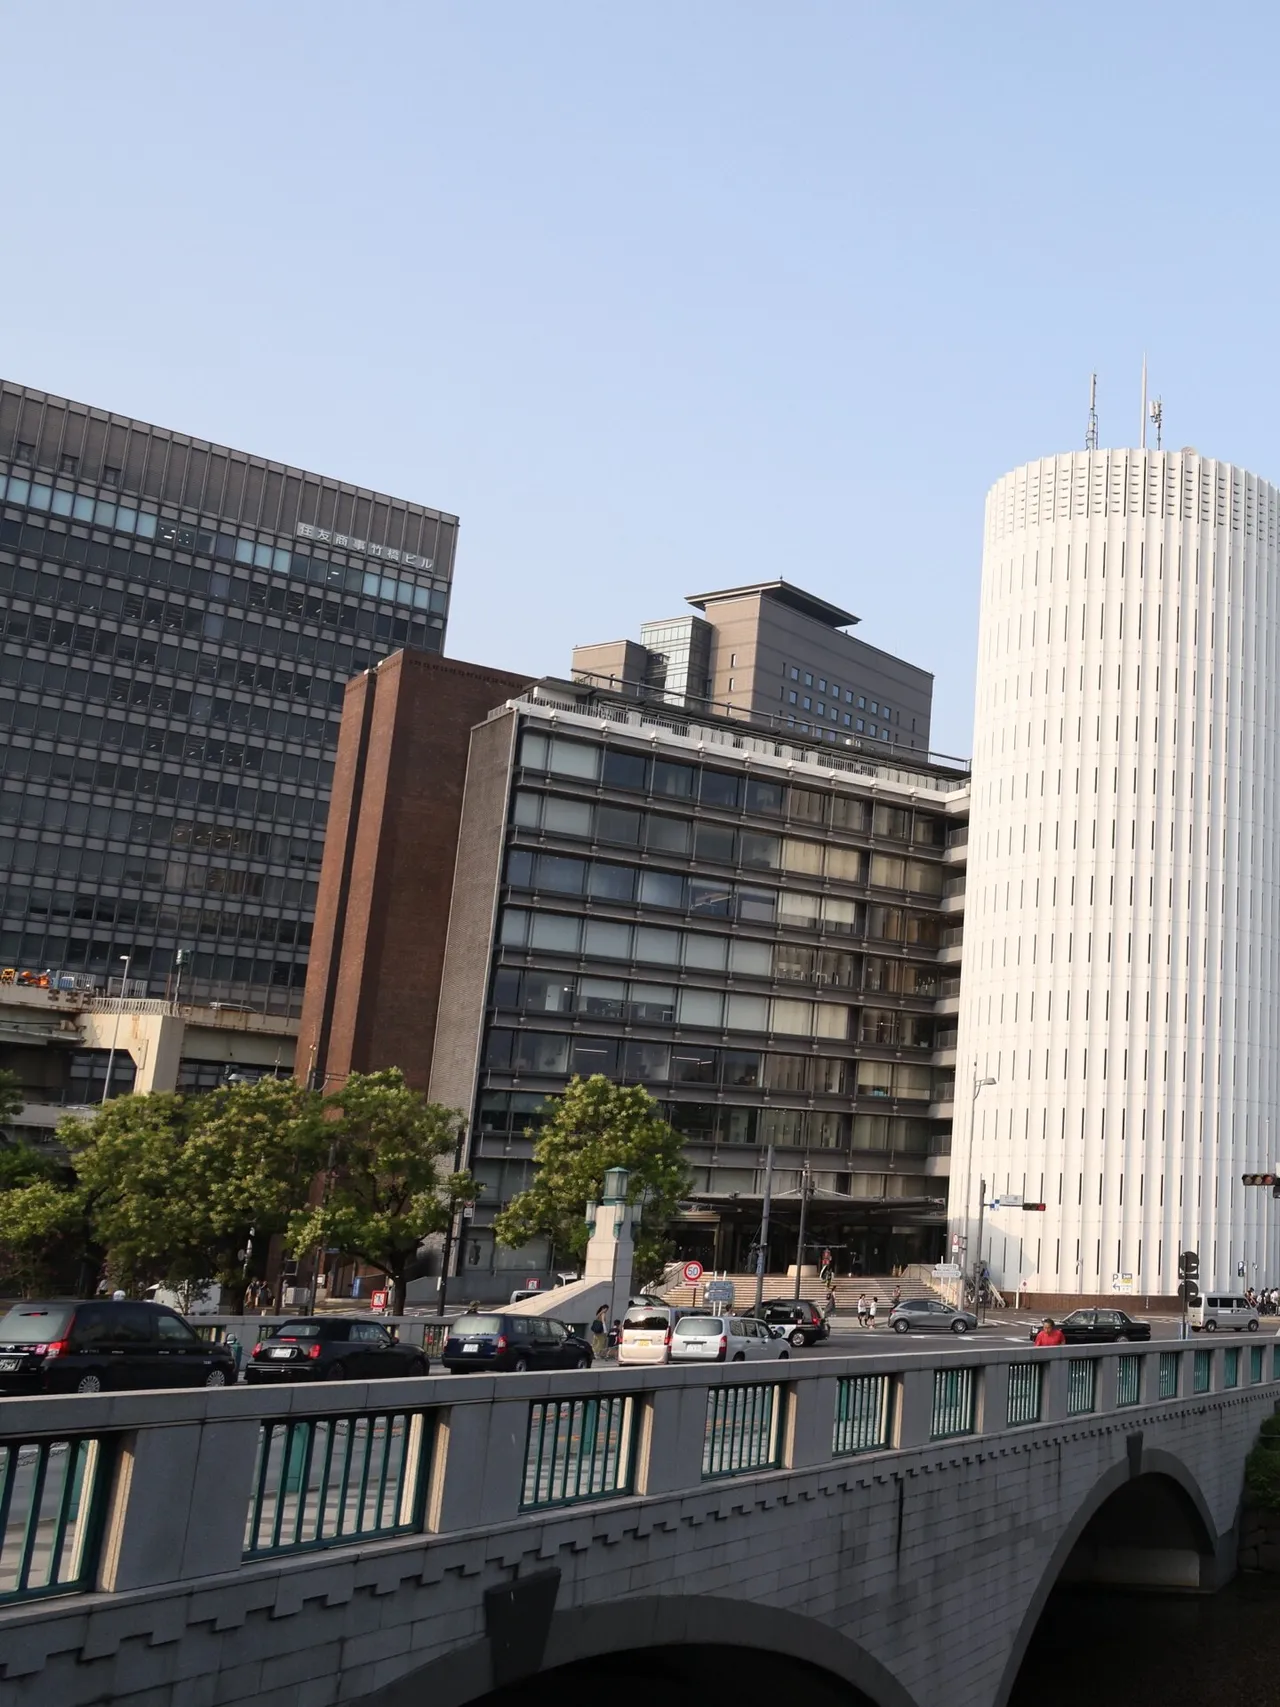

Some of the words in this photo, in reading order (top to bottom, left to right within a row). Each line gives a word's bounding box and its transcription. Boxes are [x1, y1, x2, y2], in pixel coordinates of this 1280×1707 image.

[300, 524, 433, 569] 住友商事竹橋ビル
[687, 1266, 699, 1276] 50
[1112, 1273, 1119, 1283] P
